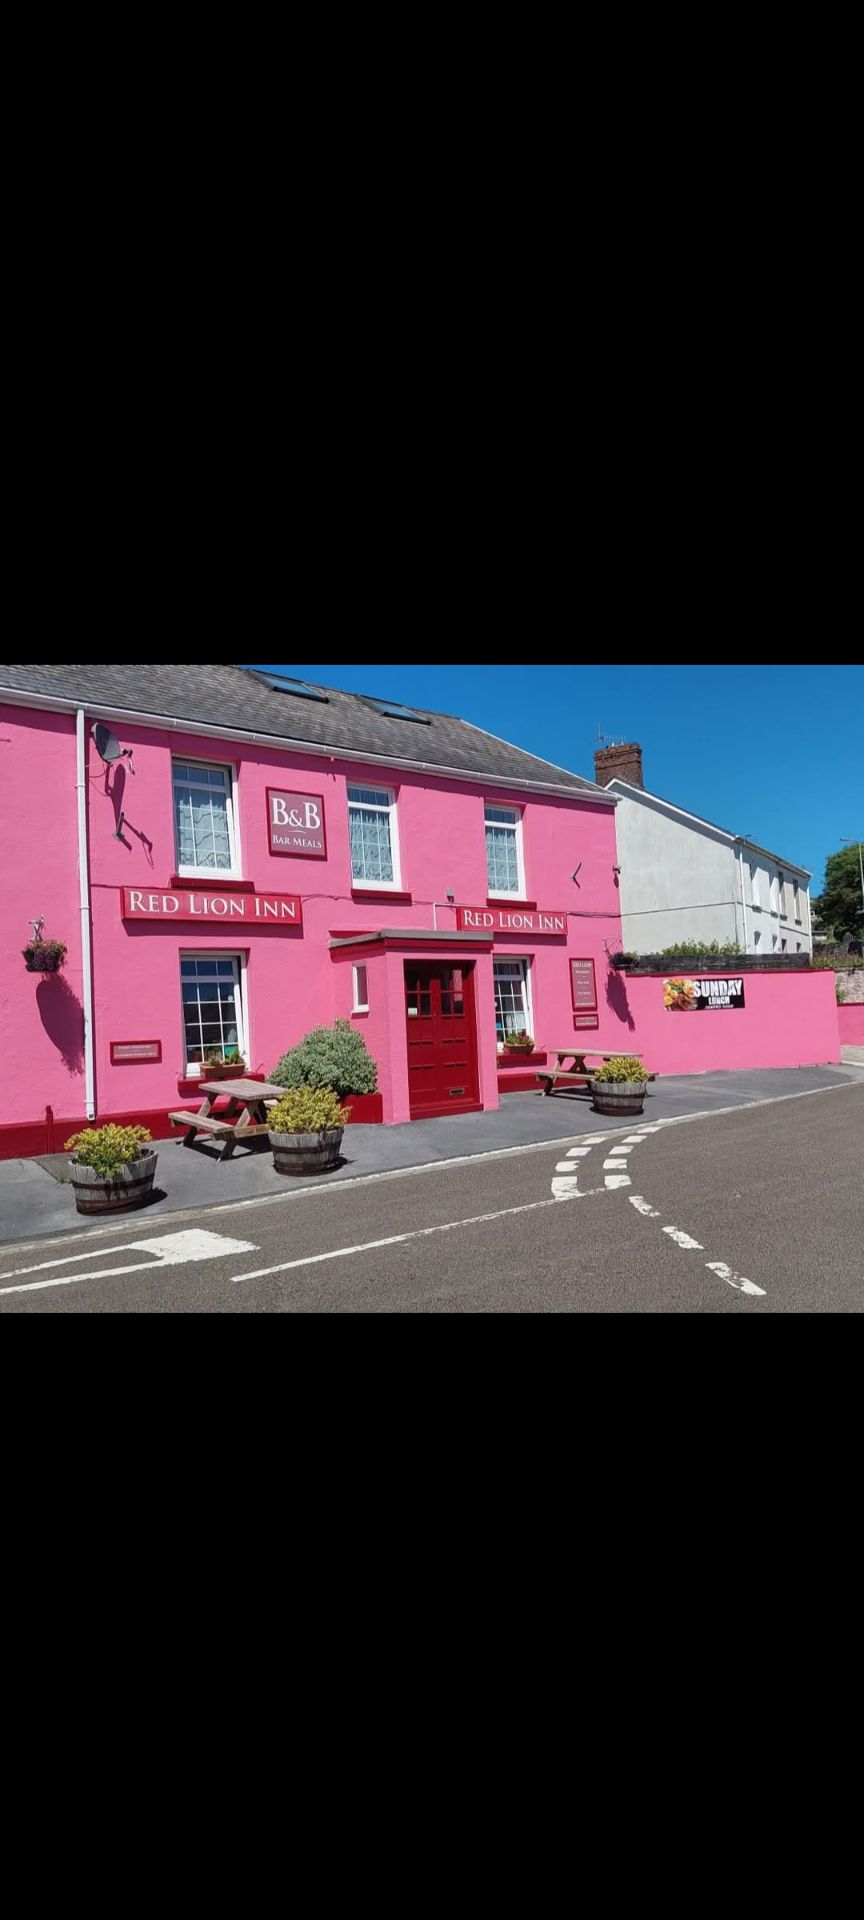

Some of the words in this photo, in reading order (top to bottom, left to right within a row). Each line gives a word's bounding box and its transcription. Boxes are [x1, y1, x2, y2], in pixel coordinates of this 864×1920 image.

[271, 797, 321, 829] B&B
[272, 834, 290, 845] BAR
[293, 837, 322, 849] MEALS
[128, 891, 179, 913] RED
[188, 894, 246, 916] LION
[254, 897, 296, 918] INN
[463, 909, 494, 927] RED
[499, 911, 533, 928] LION
[538, 913, 564, 930] INN
[692, 980, 742, 997] SUNDAY
[708, 996, 730, 1005] LUNCH
